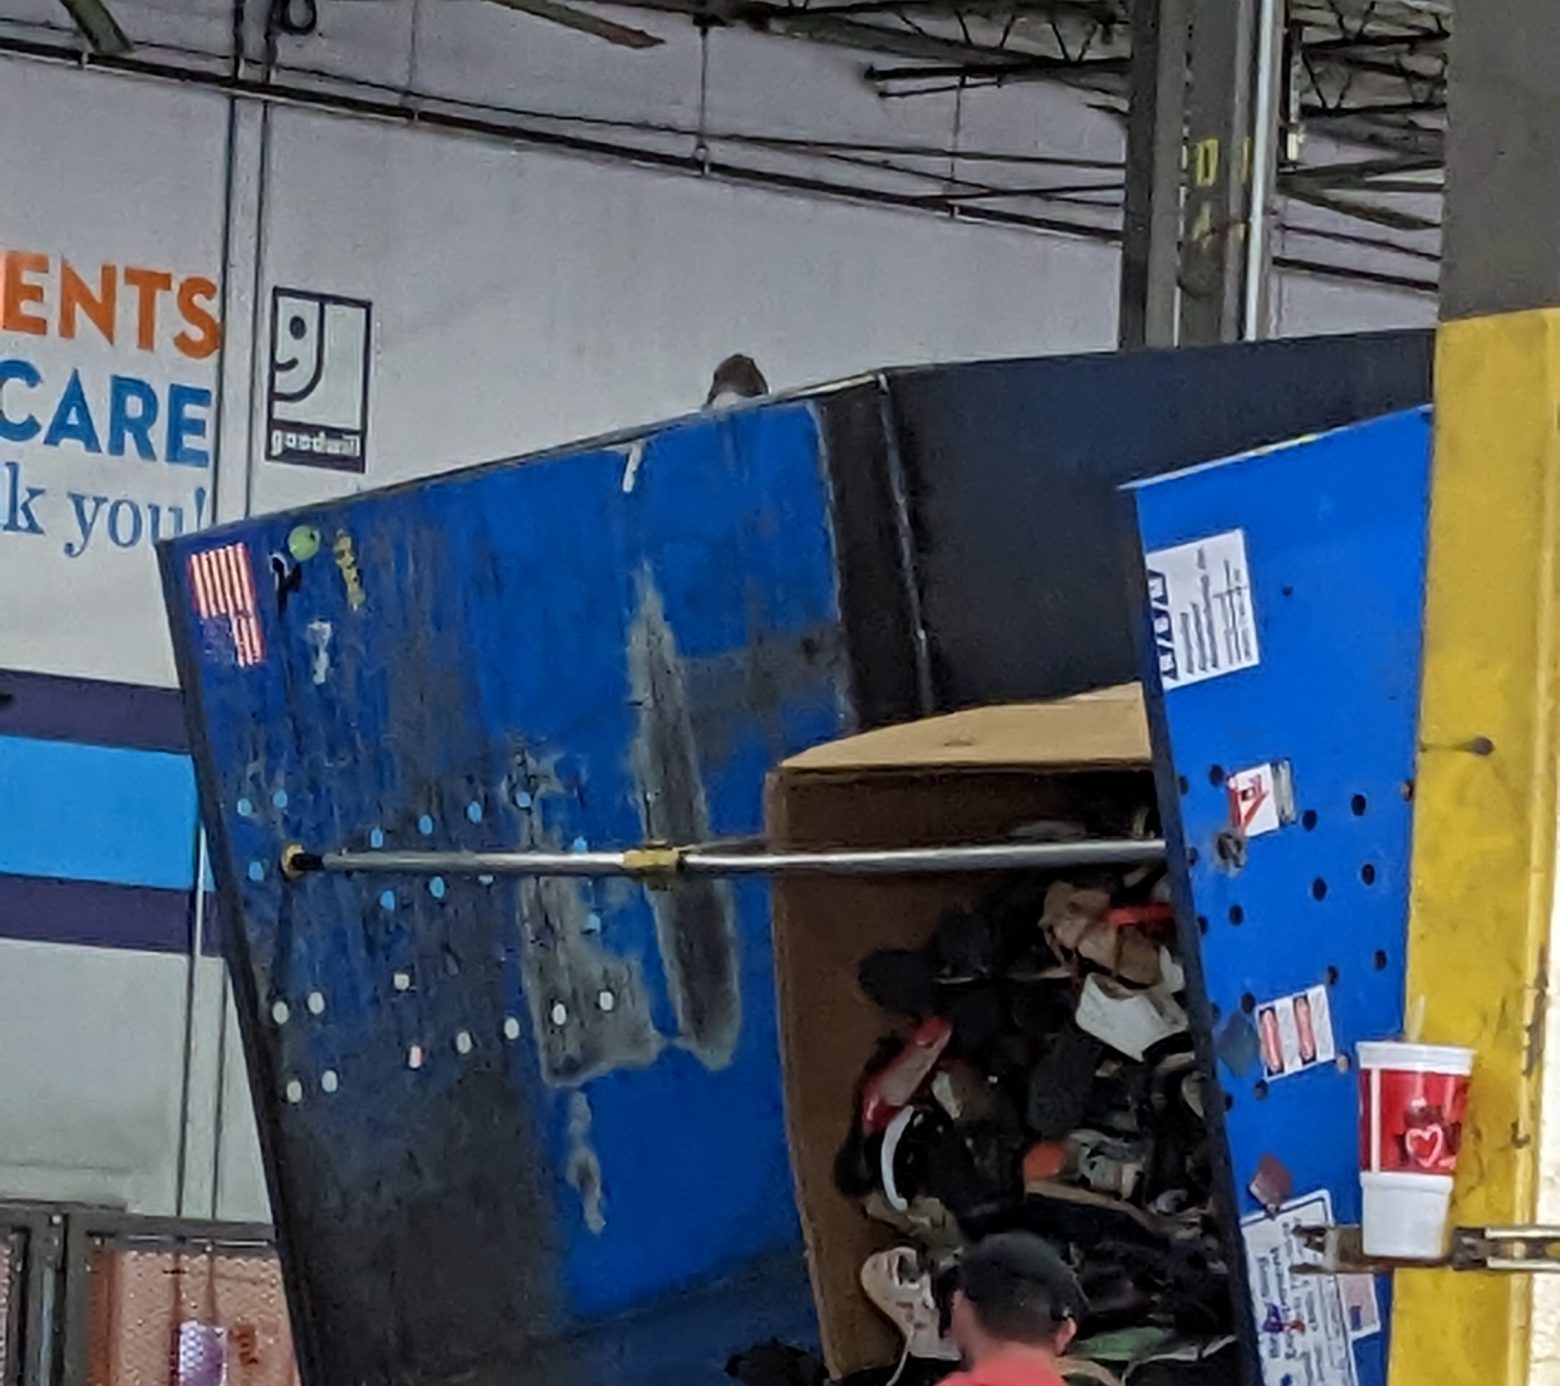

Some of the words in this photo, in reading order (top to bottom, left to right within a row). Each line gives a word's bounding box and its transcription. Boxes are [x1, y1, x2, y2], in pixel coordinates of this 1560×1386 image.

[1, 250, 221, 359] ENTS
[0, 359, 212, 468] CARE
[271, 429, 360, 457] goodwill
[63, 486, 207, 558] you!
